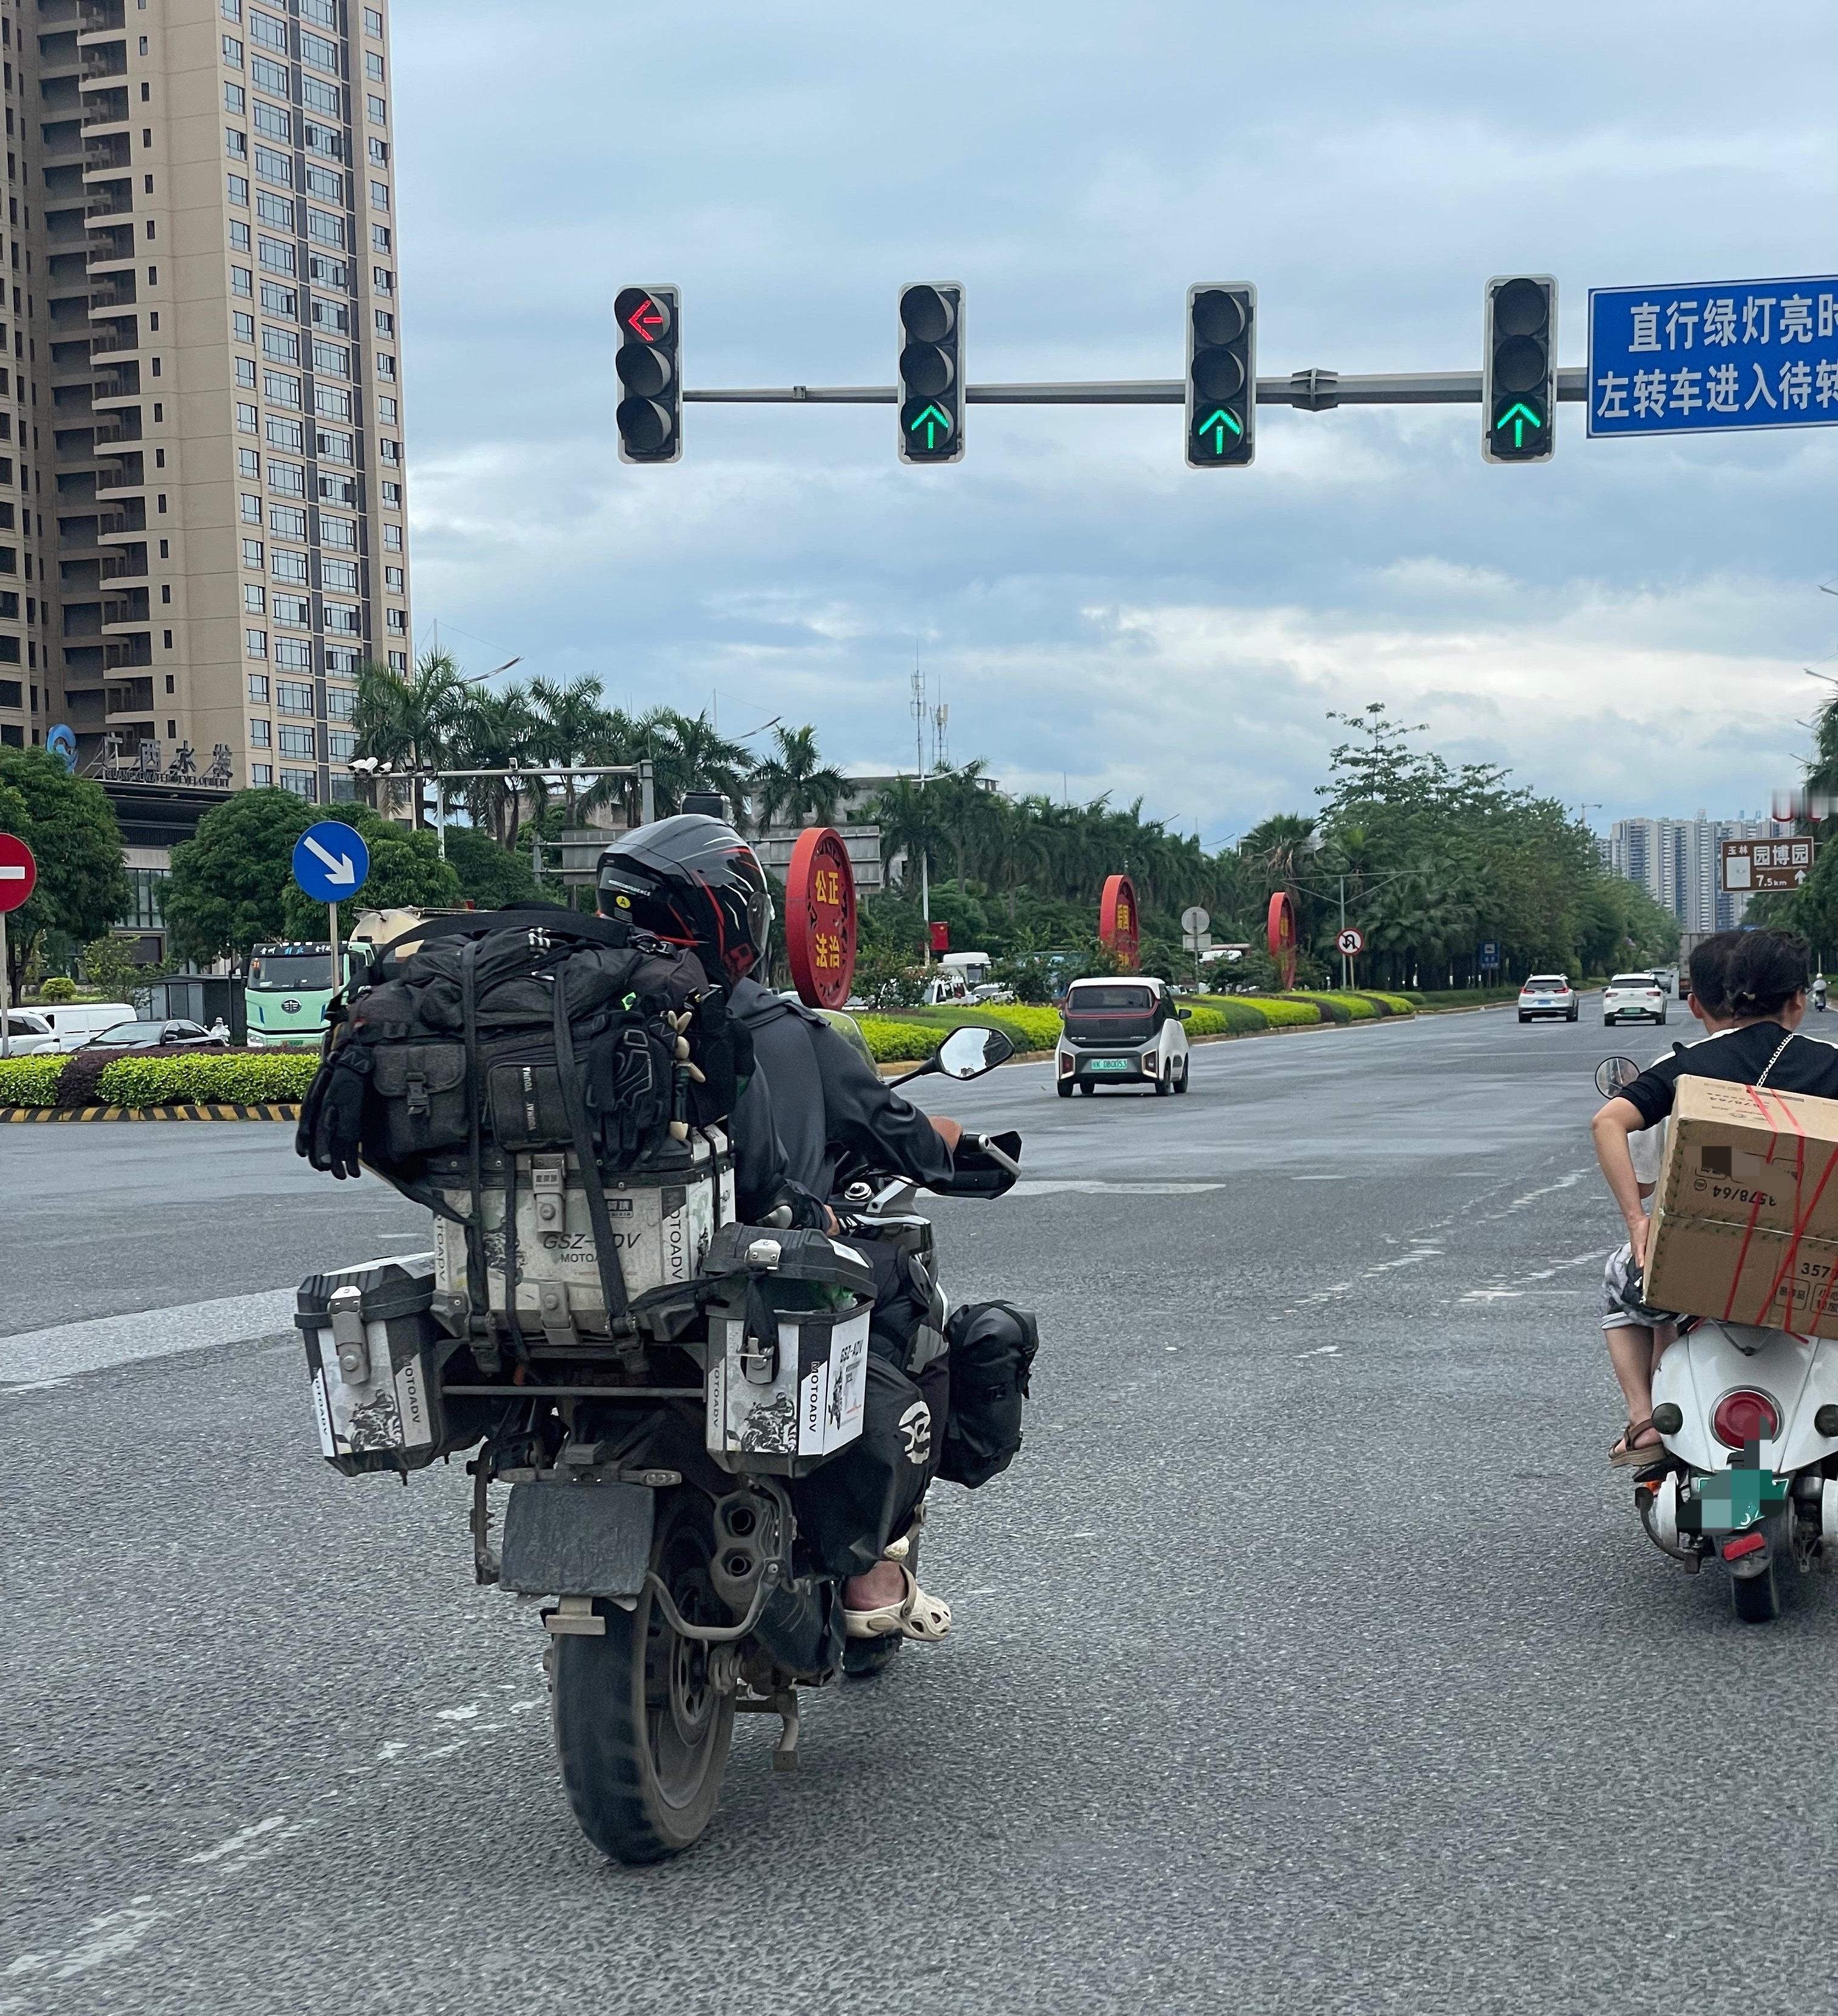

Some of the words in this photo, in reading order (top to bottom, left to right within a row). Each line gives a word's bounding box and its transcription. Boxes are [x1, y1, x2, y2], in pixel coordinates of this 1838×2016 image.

[1628, 294, 1838, 352] 直行绿灯亮时
[1597, 359, 1838, 418] 左转车进入待转
[1728, 845, 1748, 855] 玉林
[1754, 844, 1809, 866] 园博园
[815, 870, 839, 904] 公正
[816, 933, 840, 968] 法治
[543, 1233, 641, 1250] GSZ-DV
[1801, 1262, 1838, 1280] 357
[808, 1361, 821, 1433] MOTOADV
